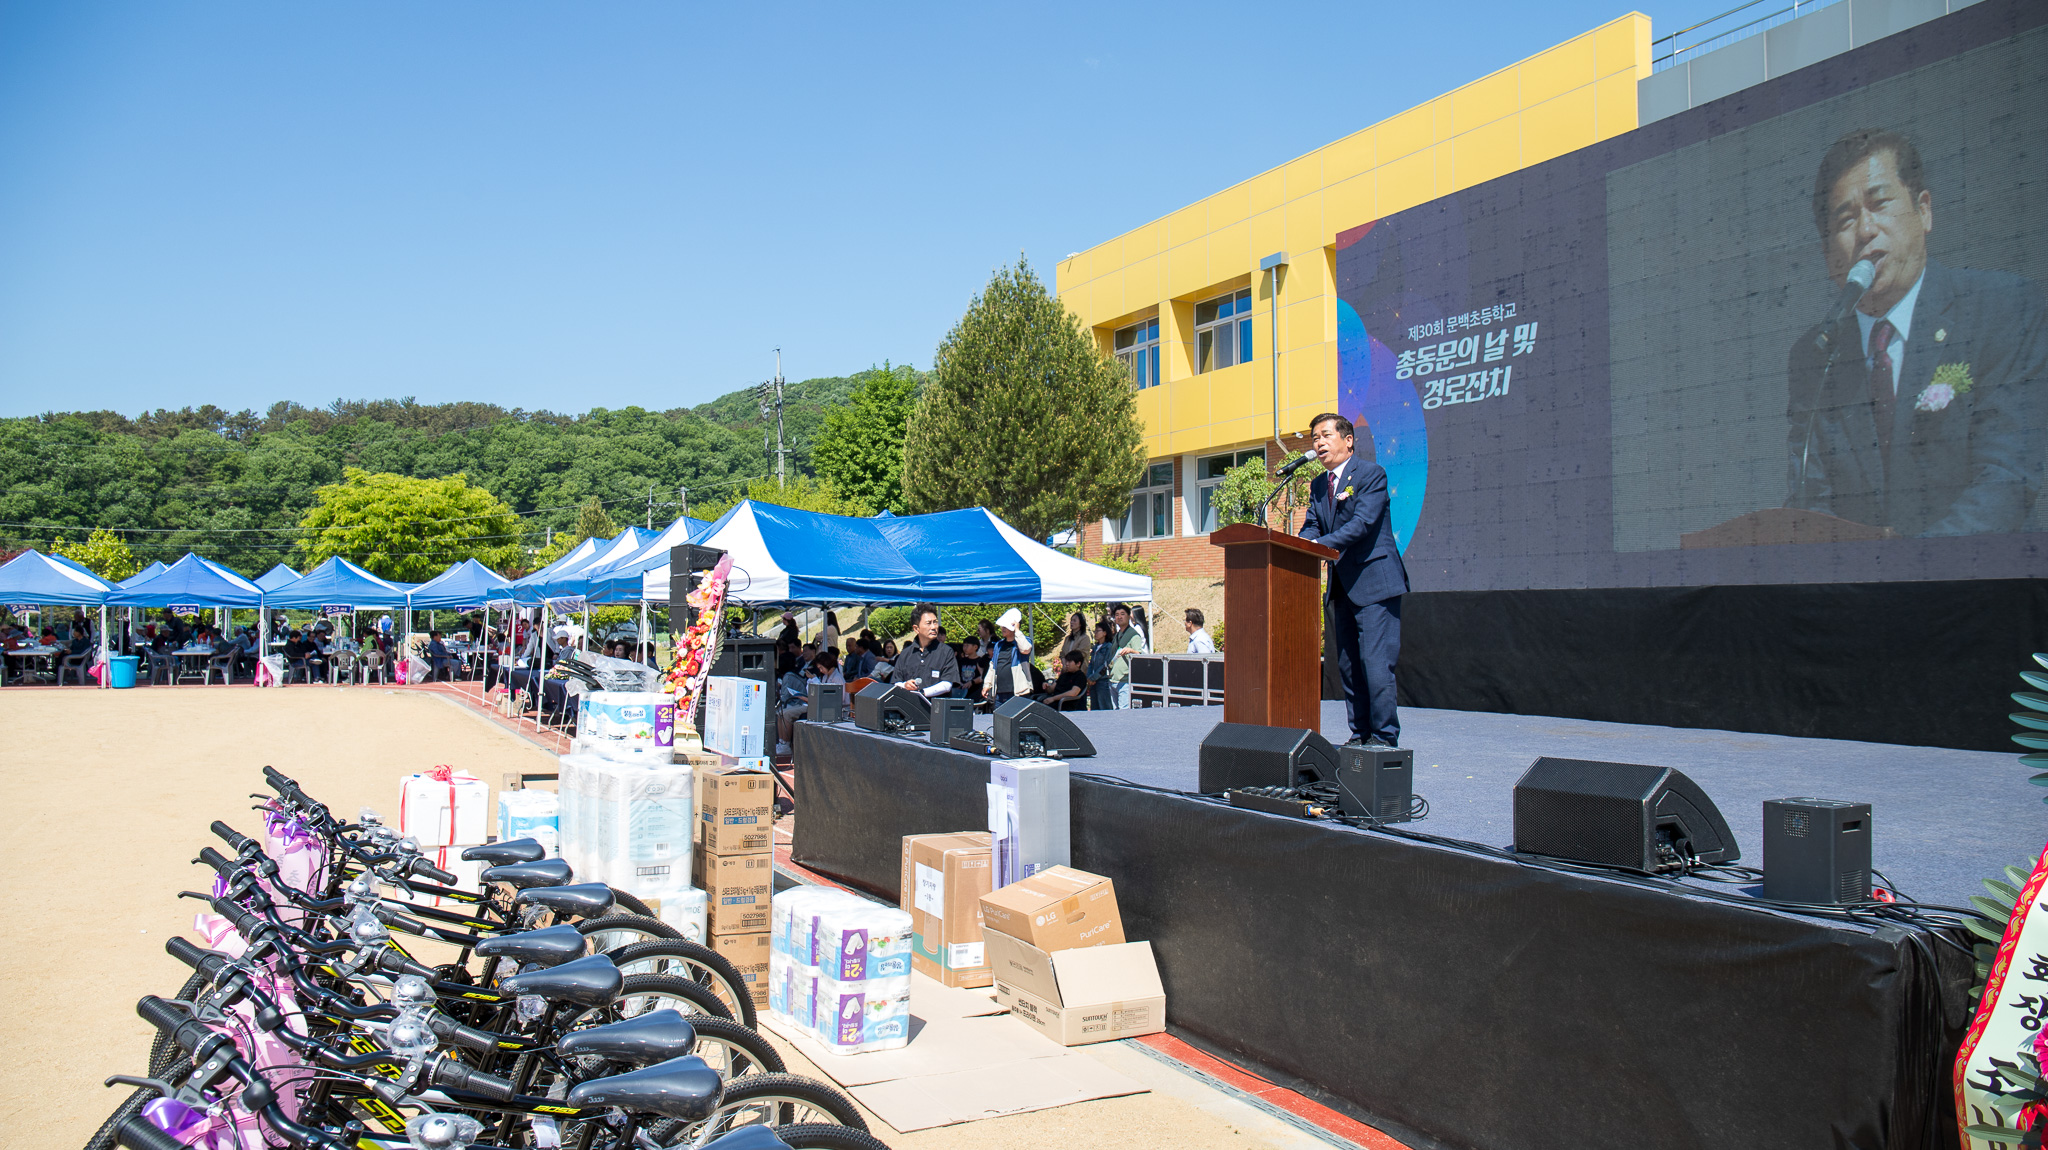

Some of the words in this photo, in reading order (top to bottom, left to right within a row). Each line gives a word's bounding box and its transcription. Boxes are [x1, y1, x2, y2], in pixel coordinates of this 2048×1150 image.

[1407, 319, 1445, 342] 제30회
[1446, 302, 1517, 333] 문백초등학교
[1394, 334, 1480, 380] 총동문의
[1482, 328, 1509, 363] 날
[1512, 321, 1539, 355] 및
[1421, 365, 1513, 410] 경로잔치
[1045, 911, 1057, 922] LG
[1082, 1012, 1108, 1023] SUNTOUCH
